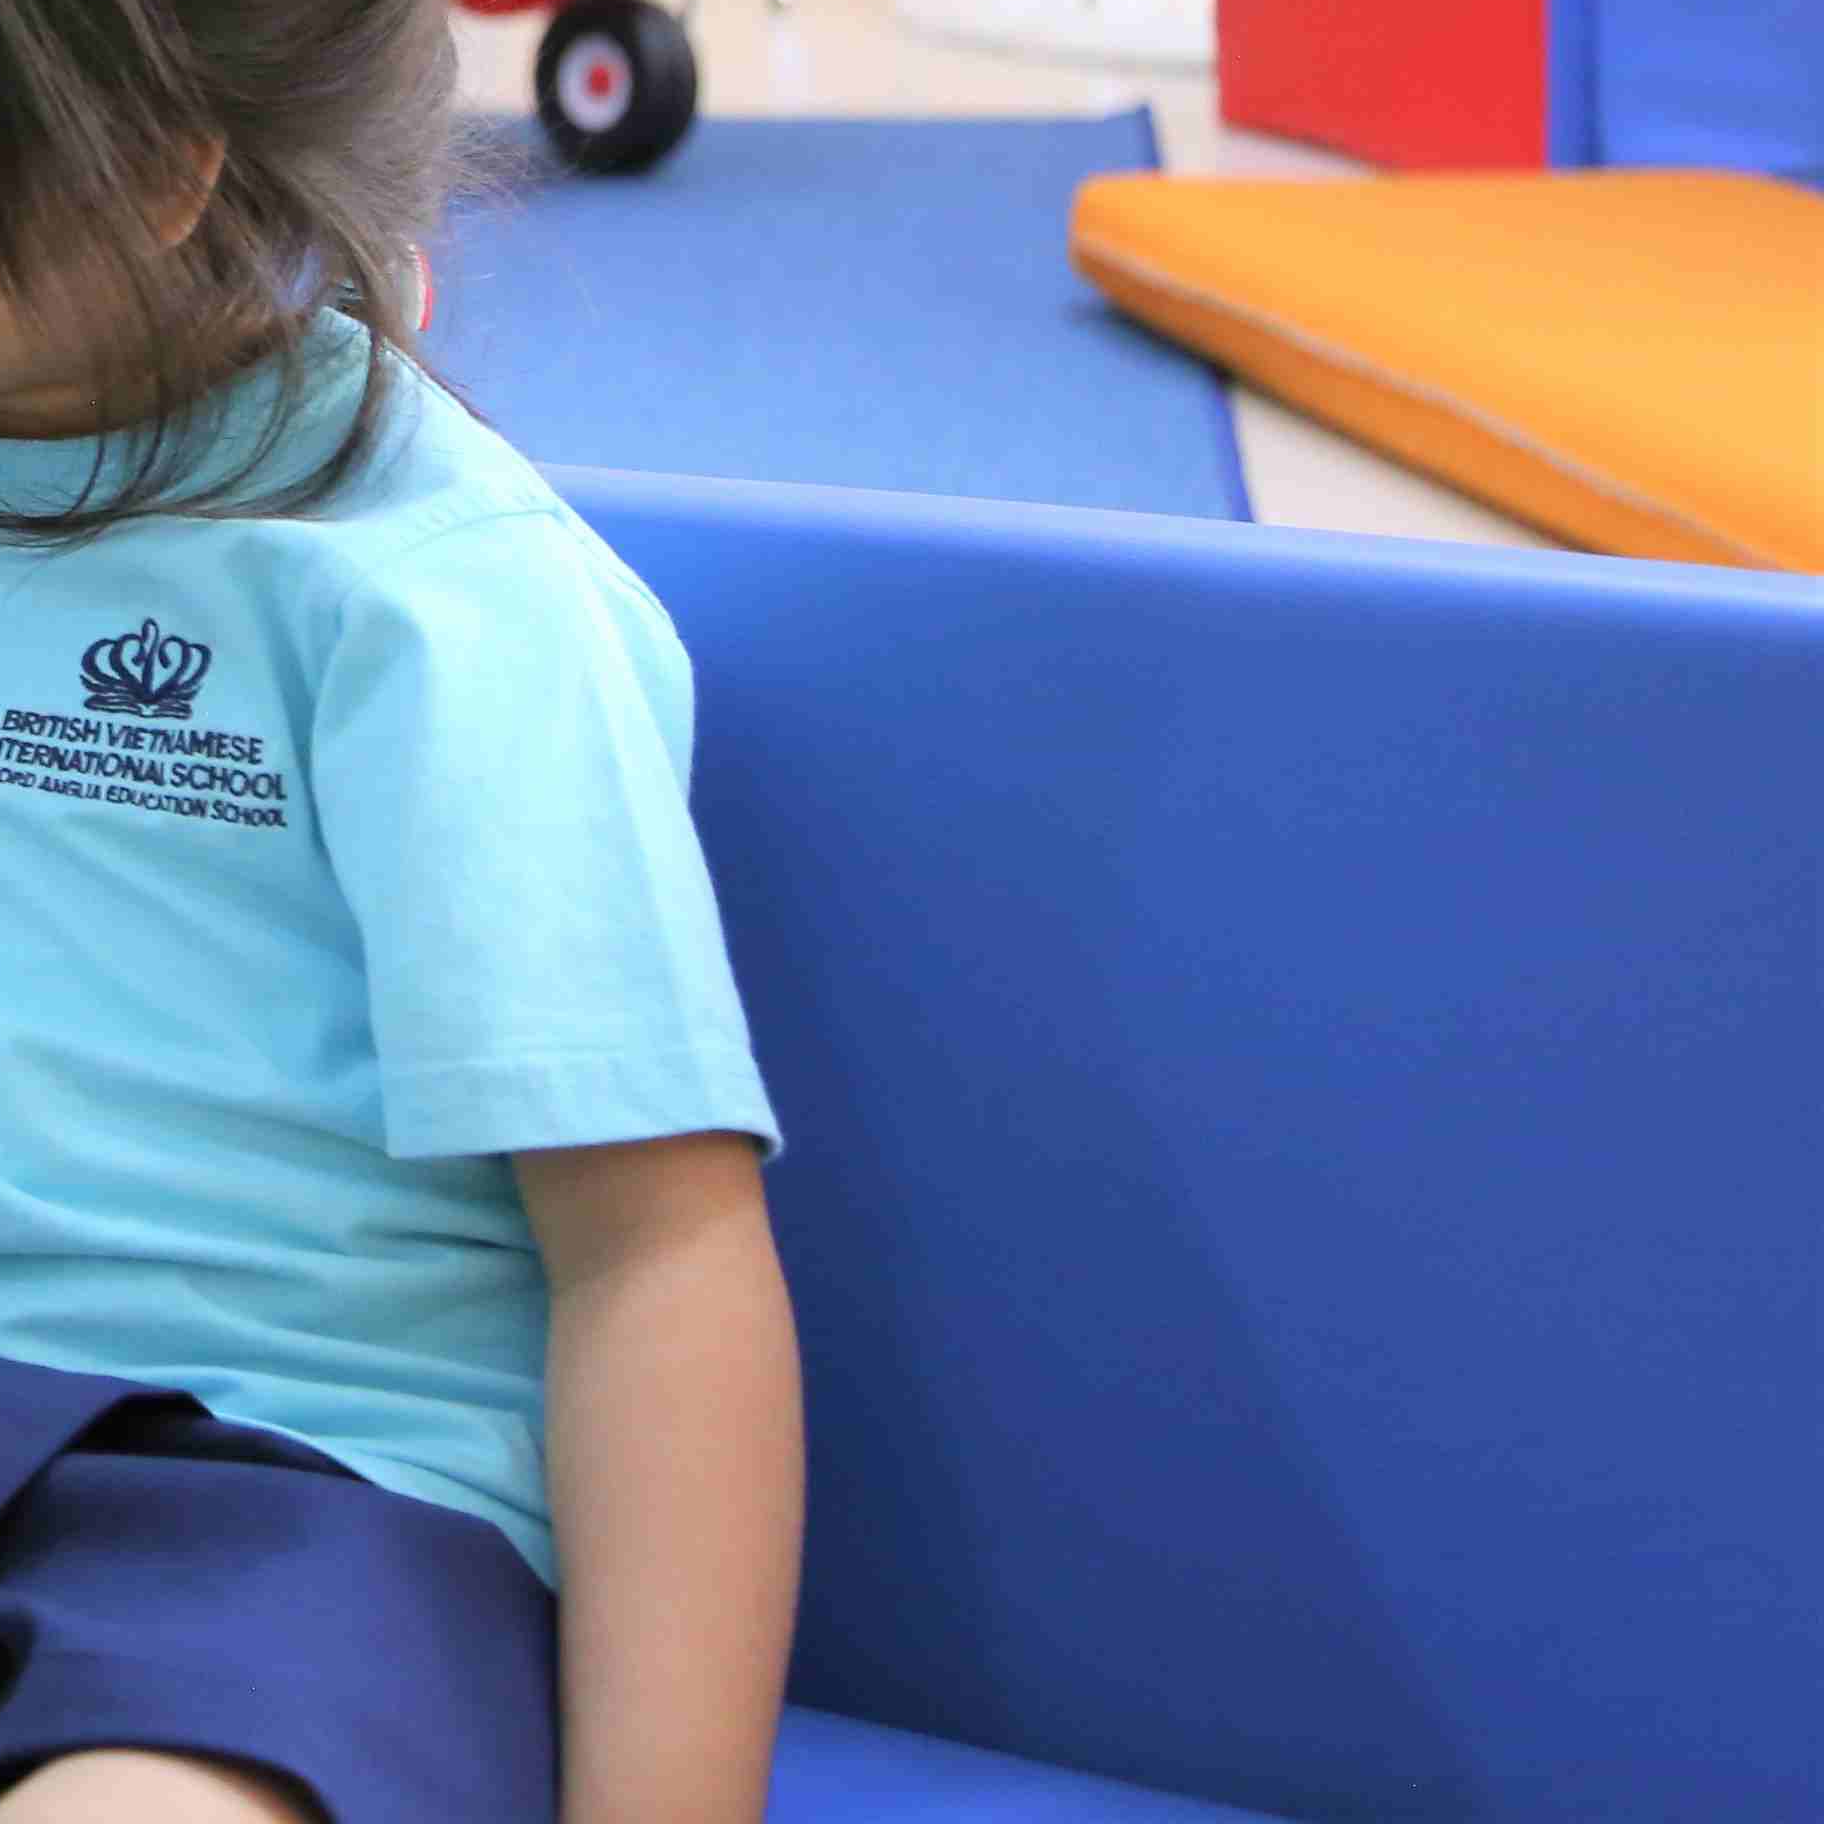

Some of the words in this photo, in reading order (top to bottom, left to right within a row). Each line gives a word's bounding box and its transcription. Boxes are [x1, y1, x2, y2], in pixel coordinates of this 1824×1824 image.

[0, 709, 101, 744] BRITISH
[106, 721, 264, 766] VIETNAMESE
[37, 774, 102, 800] ANGLIA
[105, 783, 209, 819] EDUCATION
[209, 798, 288, 828] SCHOOL
[169, 760, 288, 801] SCHOOL
